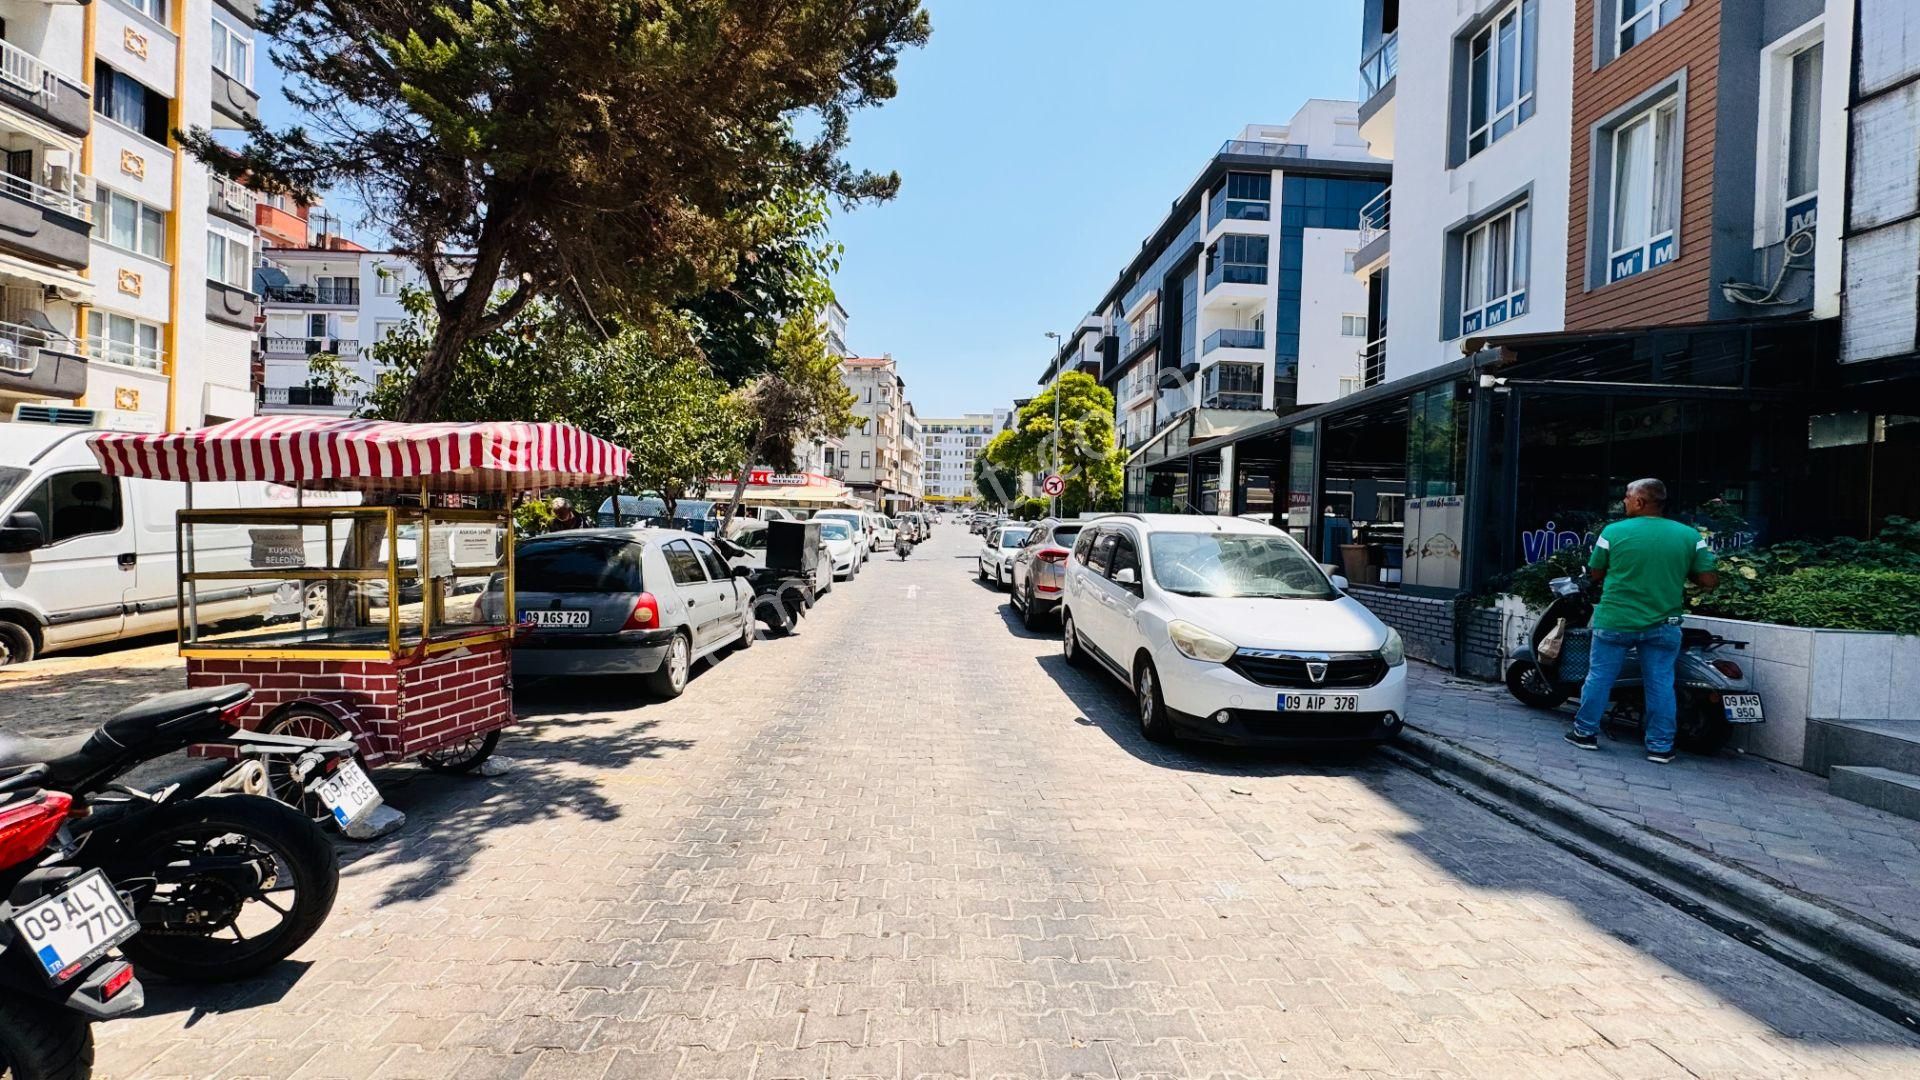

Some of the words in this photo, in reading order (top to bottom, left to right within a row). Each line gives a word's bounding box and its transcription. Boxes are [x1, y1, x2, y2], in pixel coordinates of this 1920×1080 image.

[526, 612, 540, 623] 09
[543, 612, 563, 624] AGS
[566, 612, 587, 624] 720
[1286, 696, 1301, 709] 09
[1306, 696, 1326, 710] AIP
[1334, 696, 1355, 710] 378
[1724, 696, 1738, 707] 09
[1739, 696, 1759, 707] AHS
[1736, 707, 1756, 718] 950
[323, 782, 342, 803] 09
[338, 765, 361, 789] ARF
[350, 781, 374, 806] 035
[23, 907, 62, 941] 09
[61, 879, 106, 922] ALY
[75, 904, 124, 945] 770
[47, 959, 64, 974] TR
